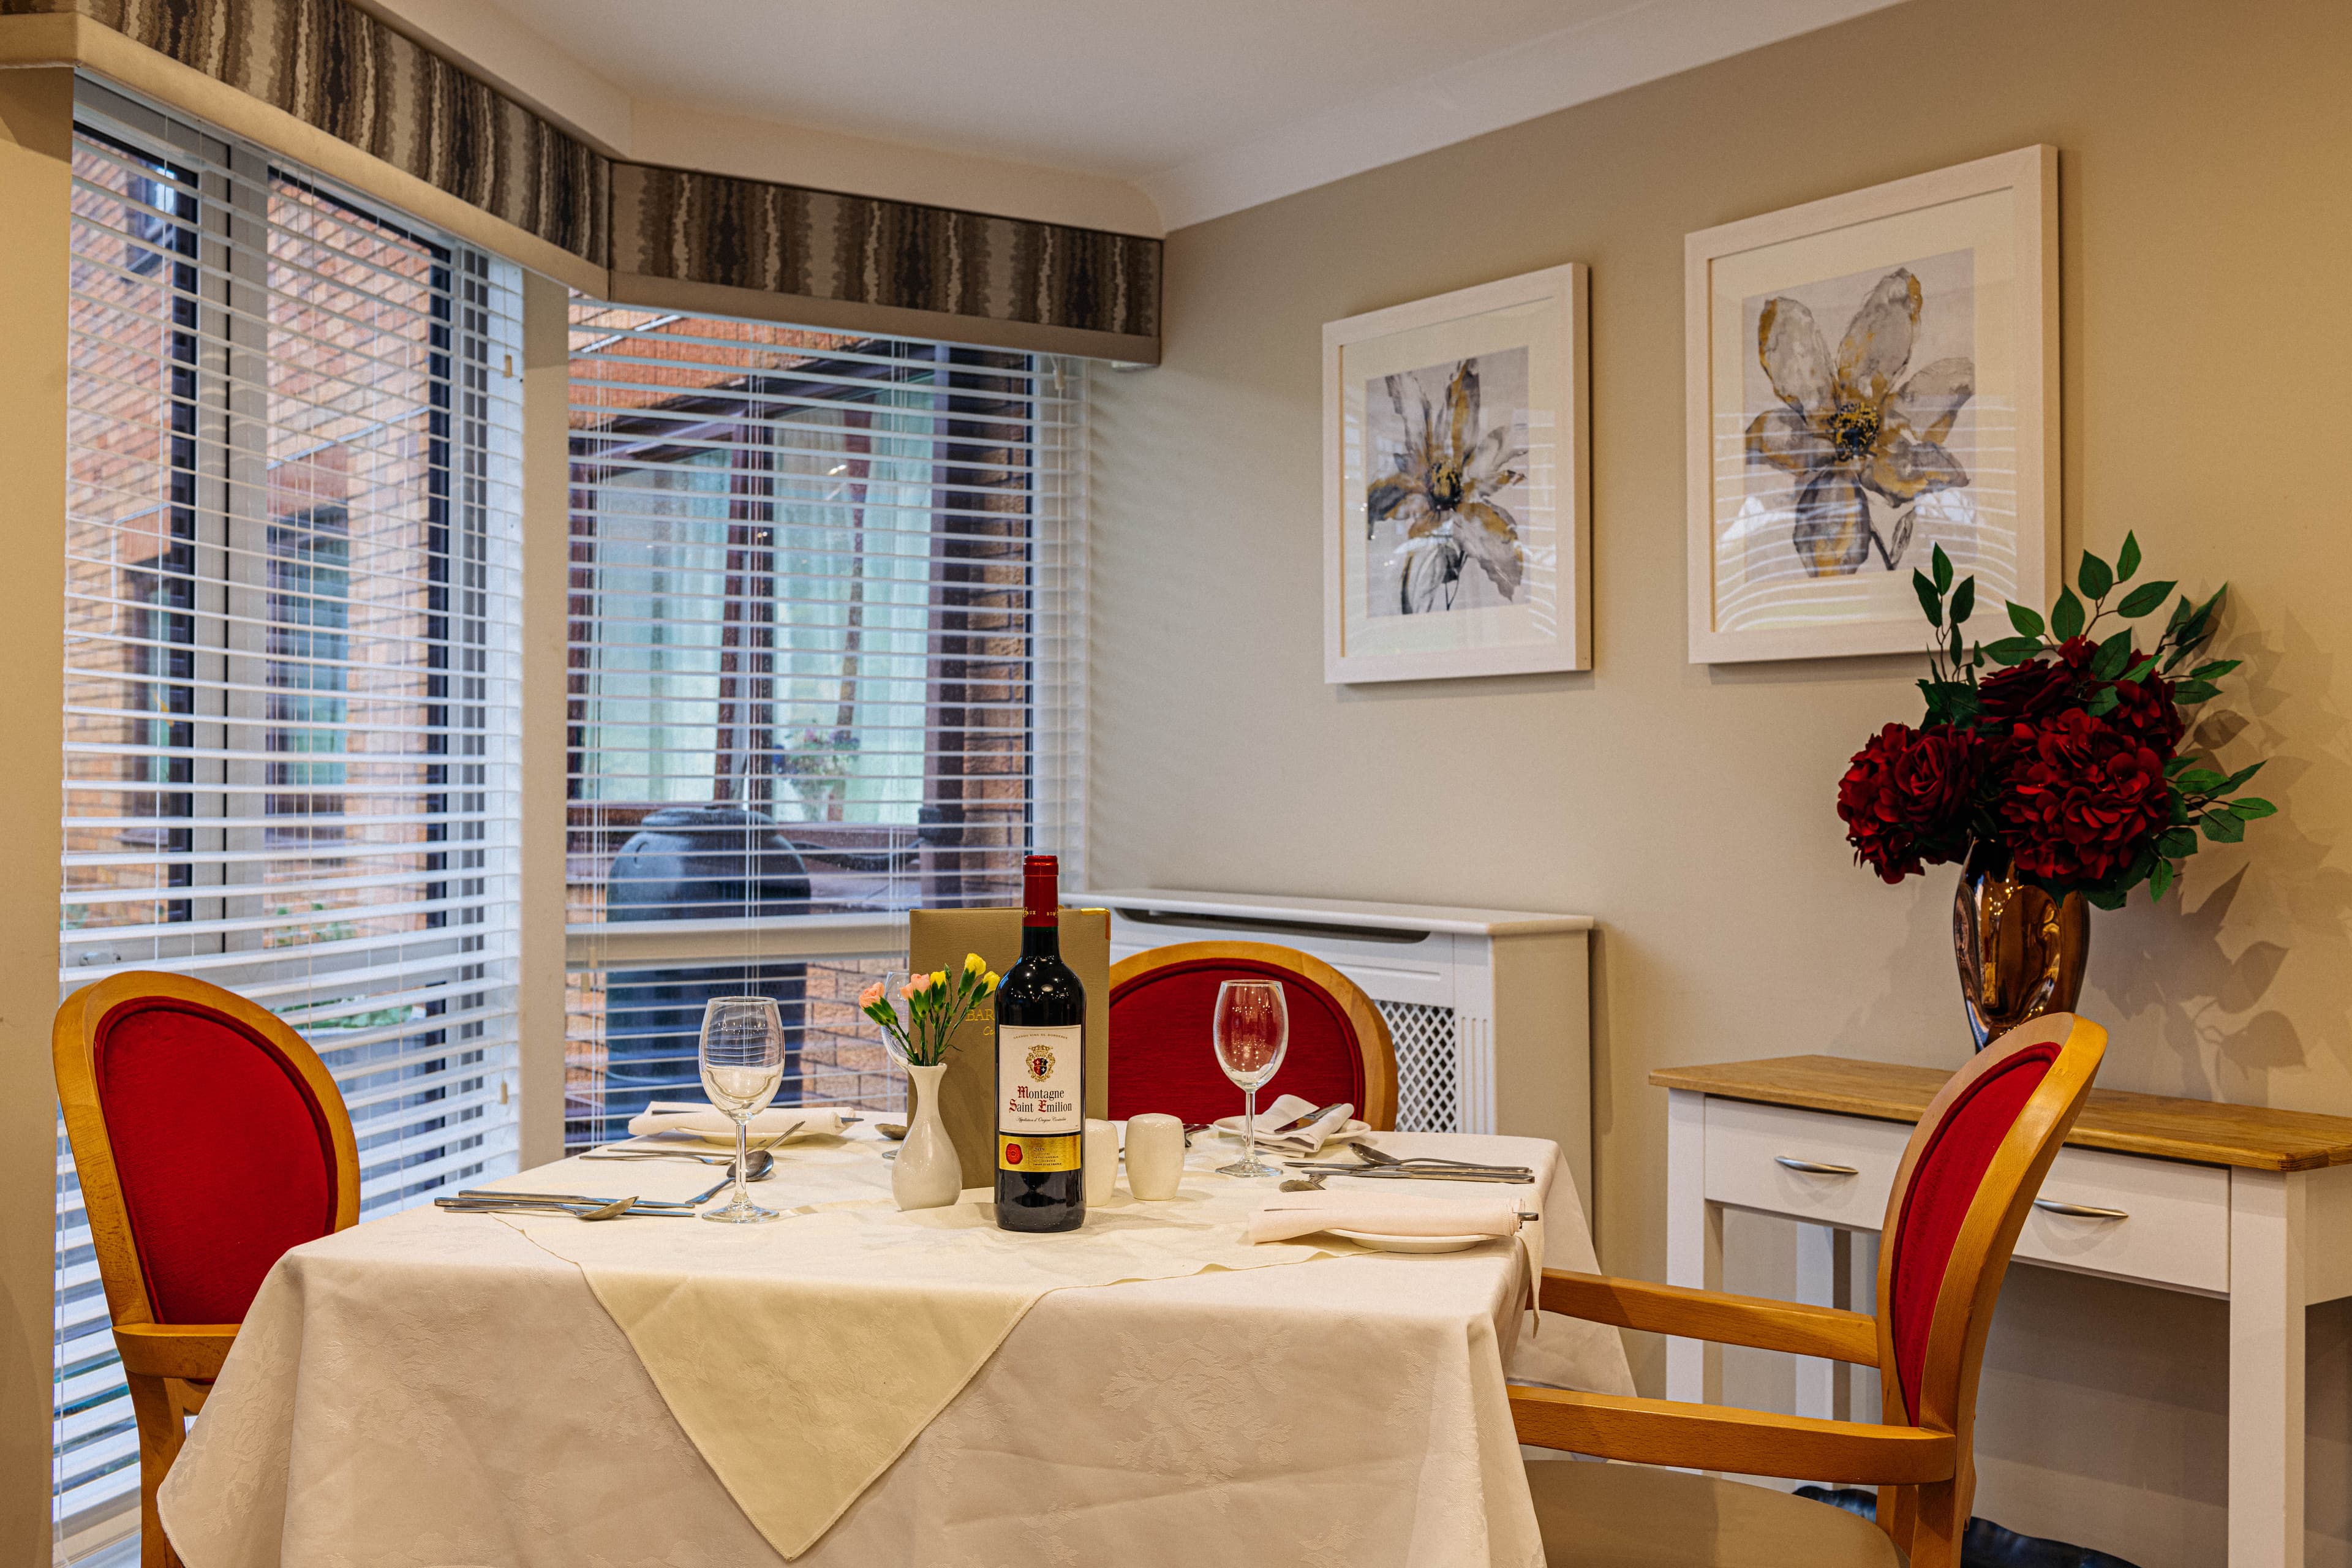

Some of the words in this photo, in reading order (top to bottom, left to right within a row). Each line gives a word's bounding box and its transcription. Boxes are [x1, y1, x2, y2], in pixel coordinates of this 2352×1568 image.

[1017, 1085, 1065, 1101] Montagne
[1009, 1098, 1034, 1113] Saint
[1038, 1099, 1072, 1113] Emilion
